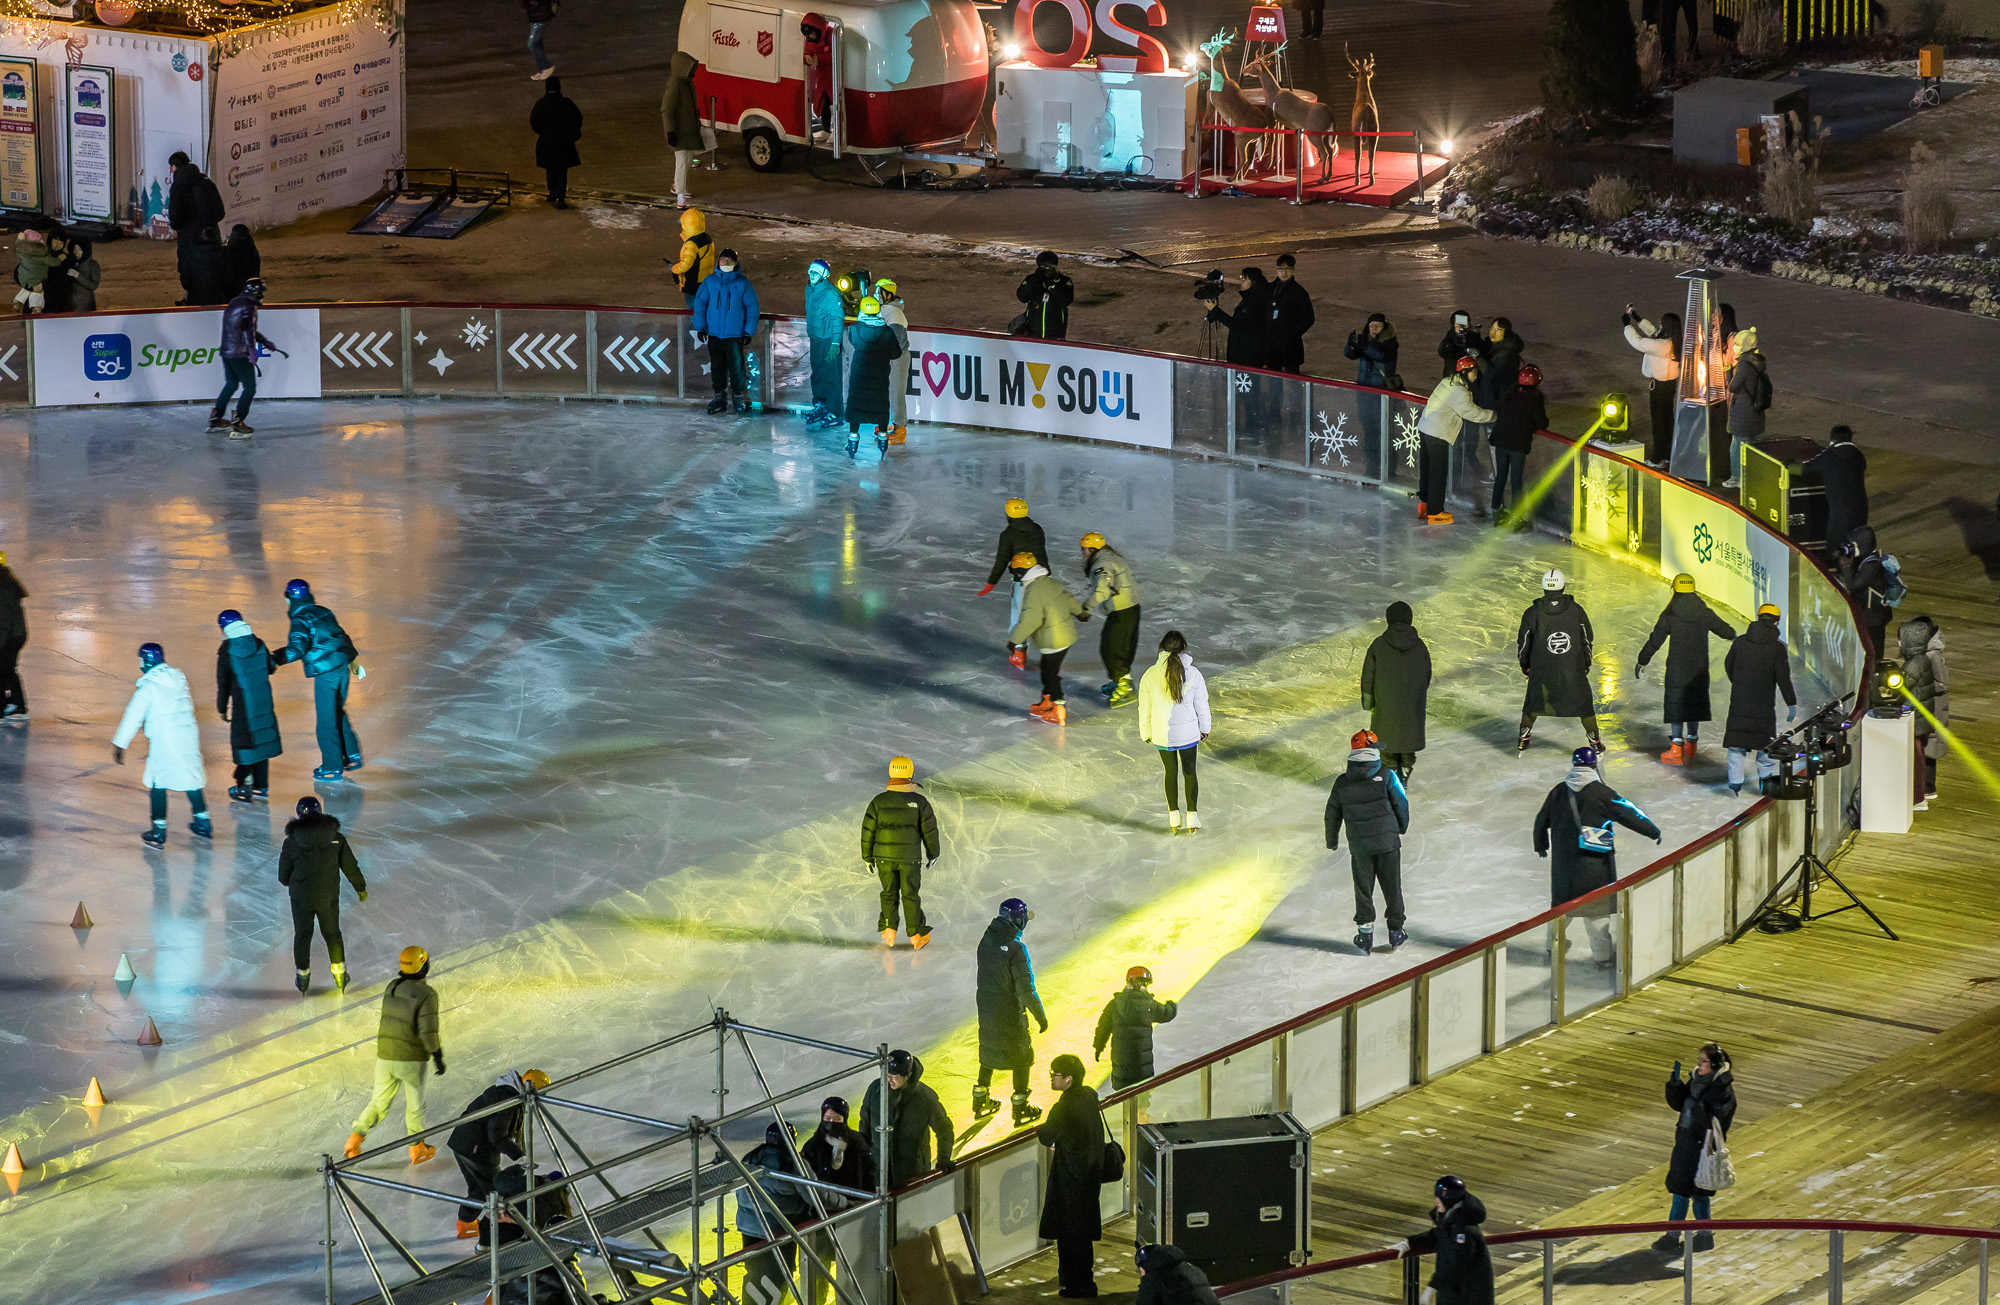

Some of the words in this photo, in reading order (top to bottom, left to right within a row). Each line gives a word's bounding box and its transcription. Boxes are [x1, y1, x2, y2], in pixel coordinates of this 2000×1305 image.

[1258, 16, 1275, 25] 구세군
[1255, 24, 1278, 33] 자선냄비
[712, 29, 740, 48] Fissler
[236, 91, 263, 106] 서울특별시
[91, 341, 105, 349] 신한
[93, 349, 120, 358] Super
[137, 343, 221, 373] Super
[1715, 540, 1767, 586] 서울특별시체육회
